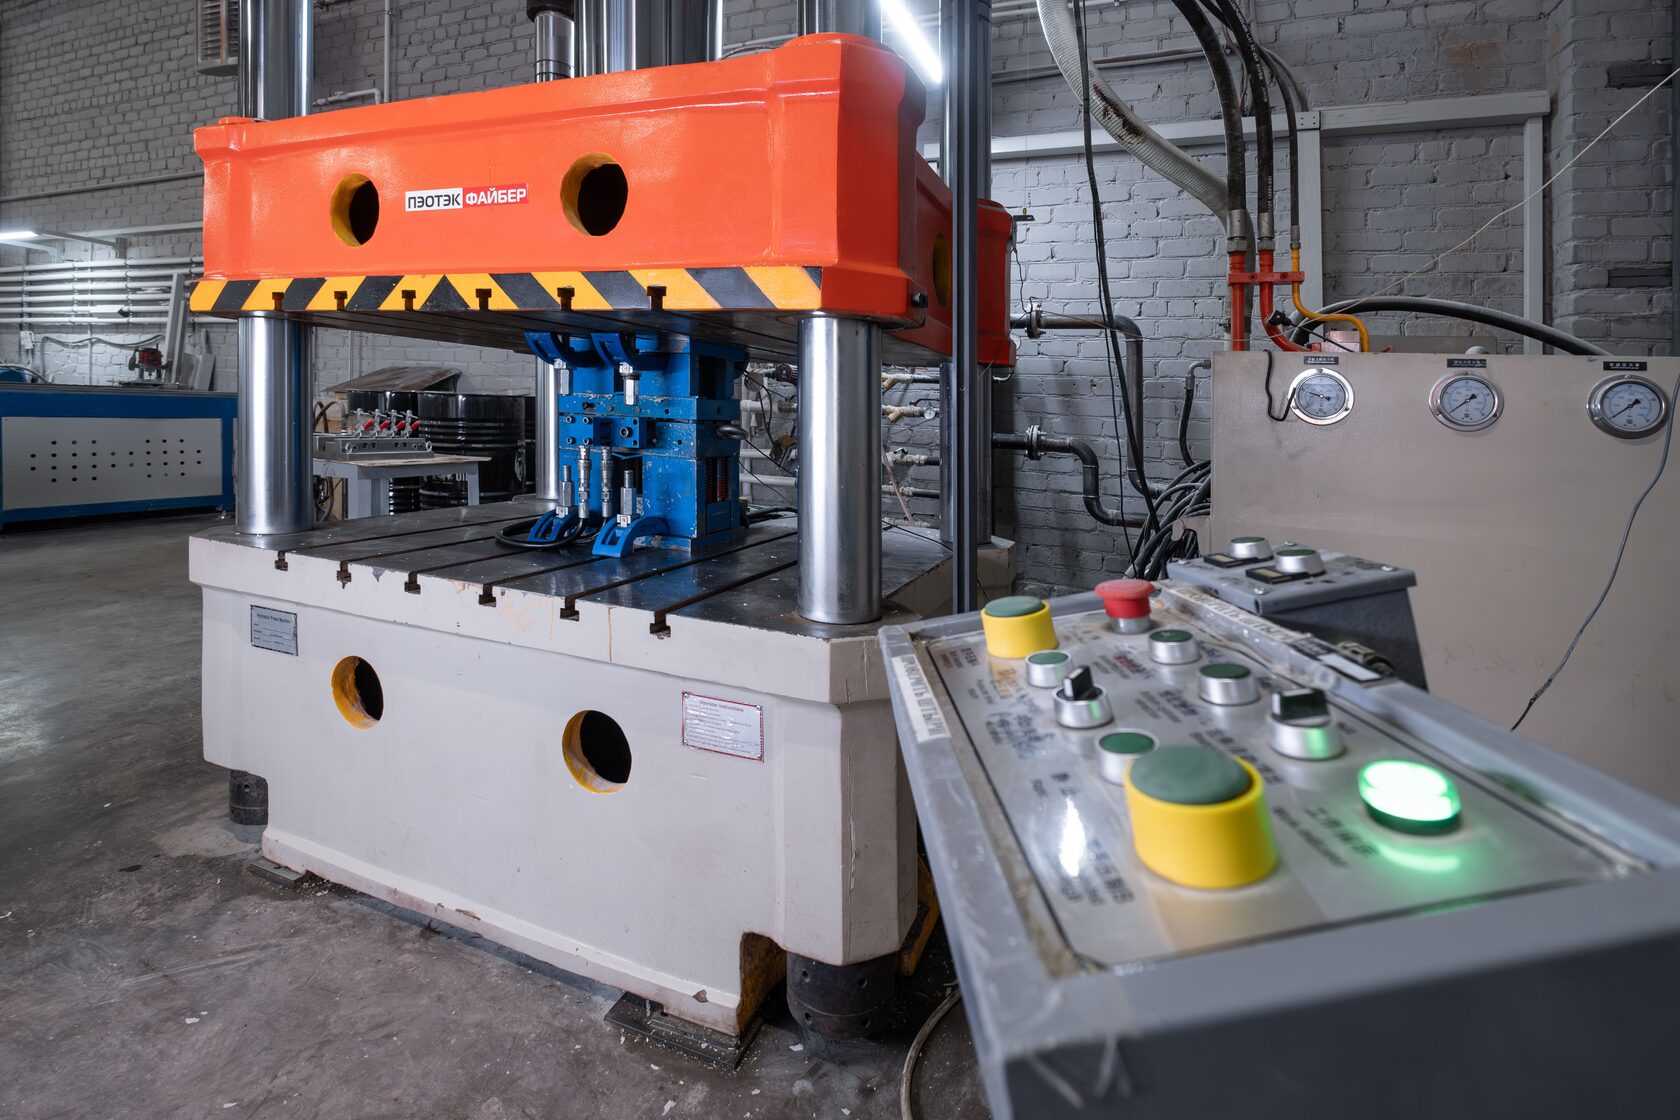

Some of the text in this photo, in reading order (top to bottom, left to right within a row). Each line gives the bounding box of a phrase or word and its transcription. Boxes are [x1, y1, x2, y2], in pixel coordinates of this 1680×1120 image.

[408, 187, 527, 209] ПЭОТЭК ФАЙБЕР
[699, 699, 718, 708] Operator
